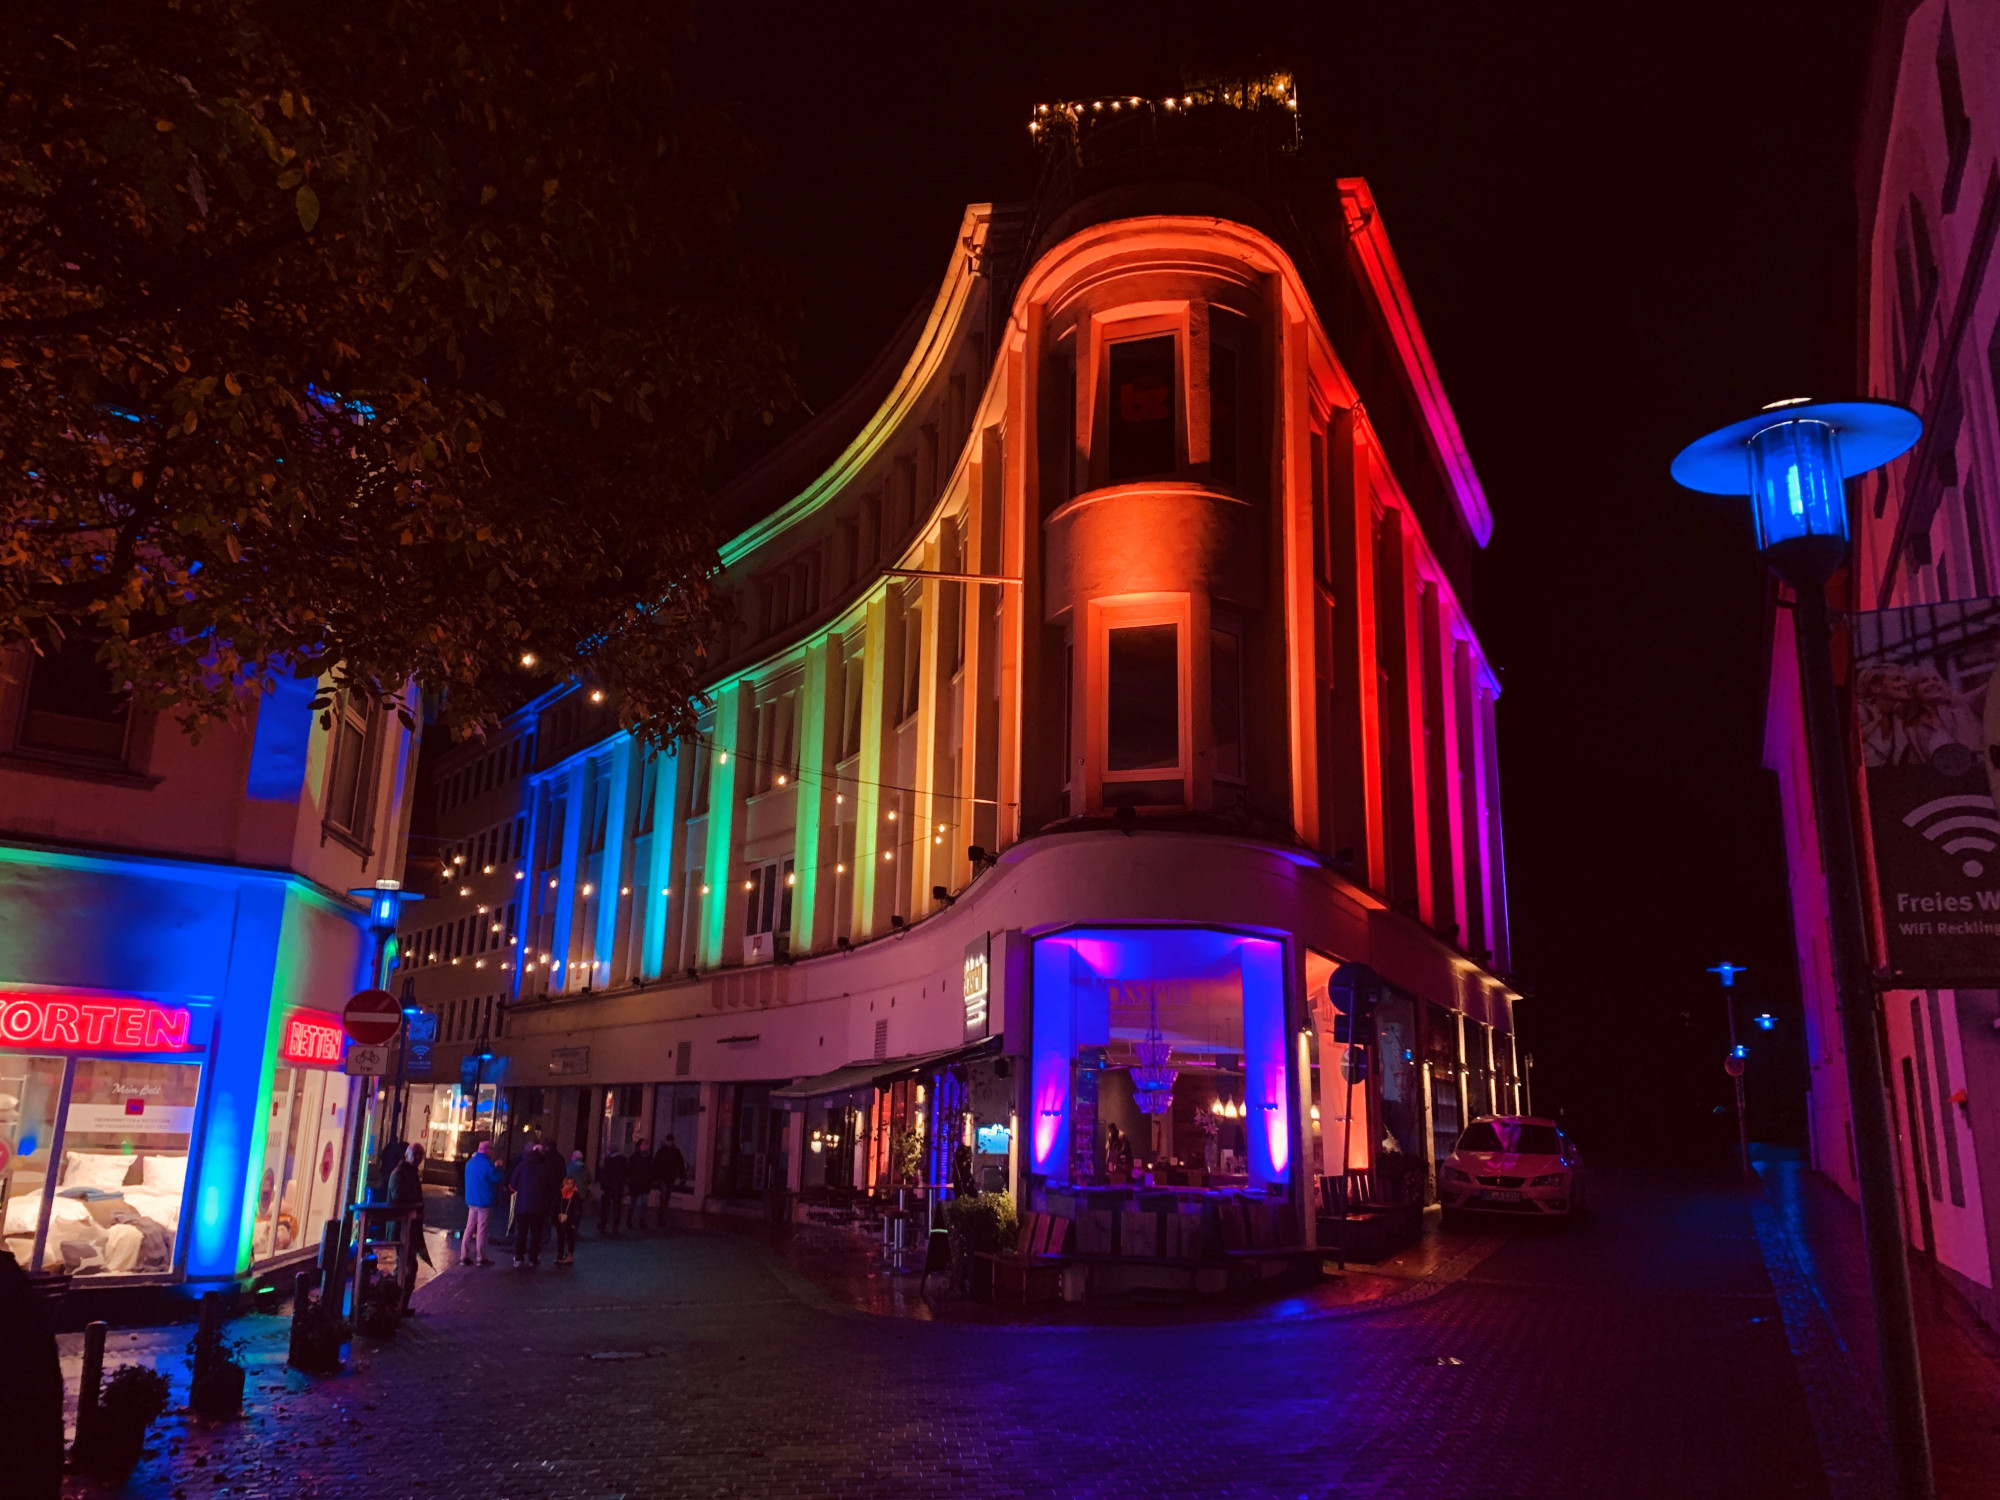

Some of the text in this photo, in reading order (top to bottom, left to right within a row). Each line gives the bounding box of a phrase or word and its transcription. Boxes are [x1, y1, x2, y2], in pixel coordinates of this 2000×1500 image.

[1897, 891, 1974, 912] Freies
[1899, 922, 1932, 935] WiFi
[289, 1021, 342, 1060] BETTEN
[112, 1083, 139, 1094] Mein
